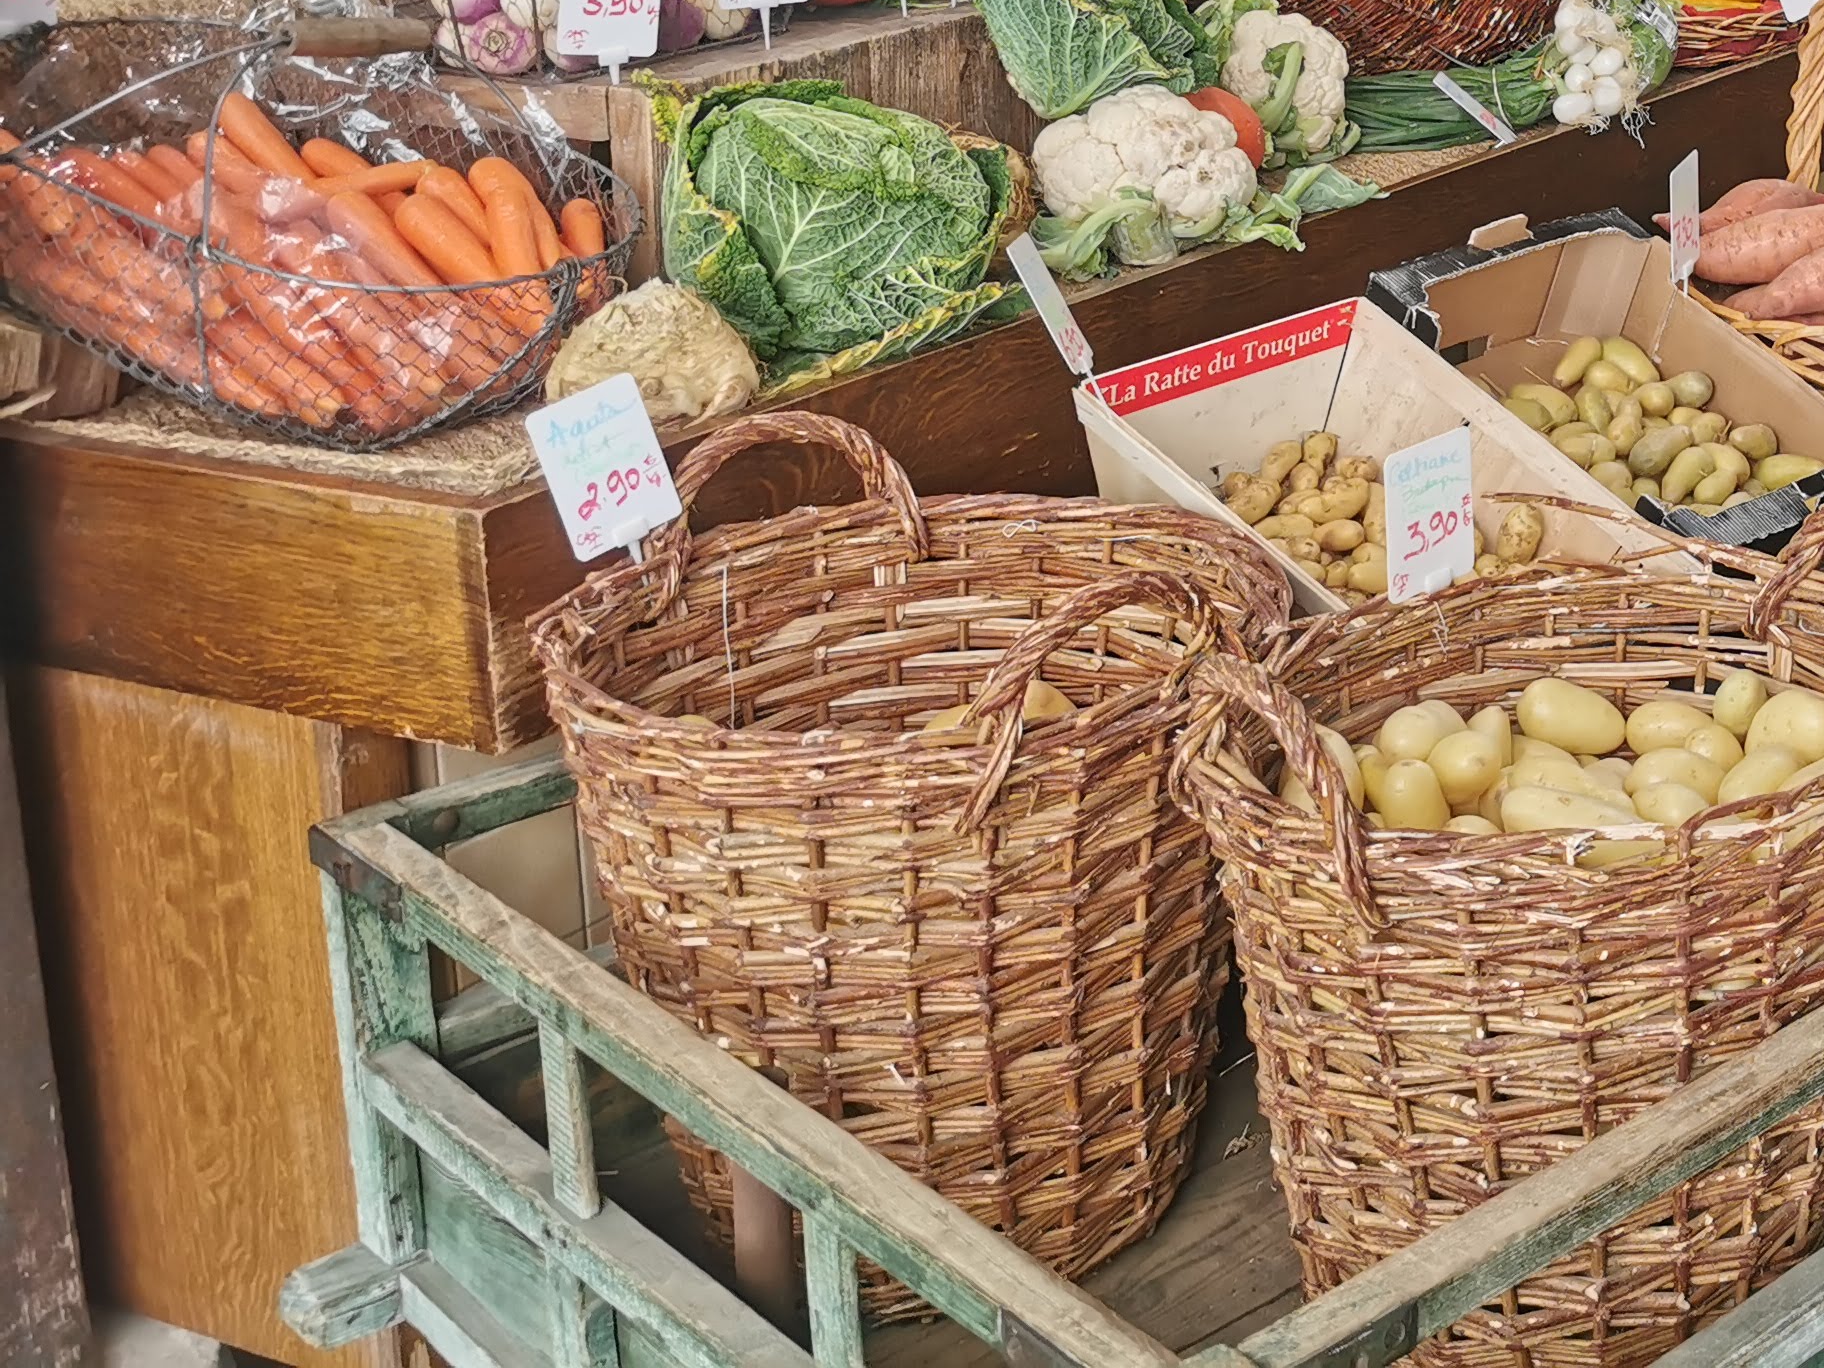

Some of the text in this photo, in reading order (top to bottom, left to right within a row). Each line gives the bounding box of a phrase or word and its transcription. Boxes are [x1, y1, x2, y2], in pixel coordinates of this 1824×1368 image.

[1107, 322, 1331, 407] La Ratte du Touquet
[1403, 510, 1458, 561] 3,90
